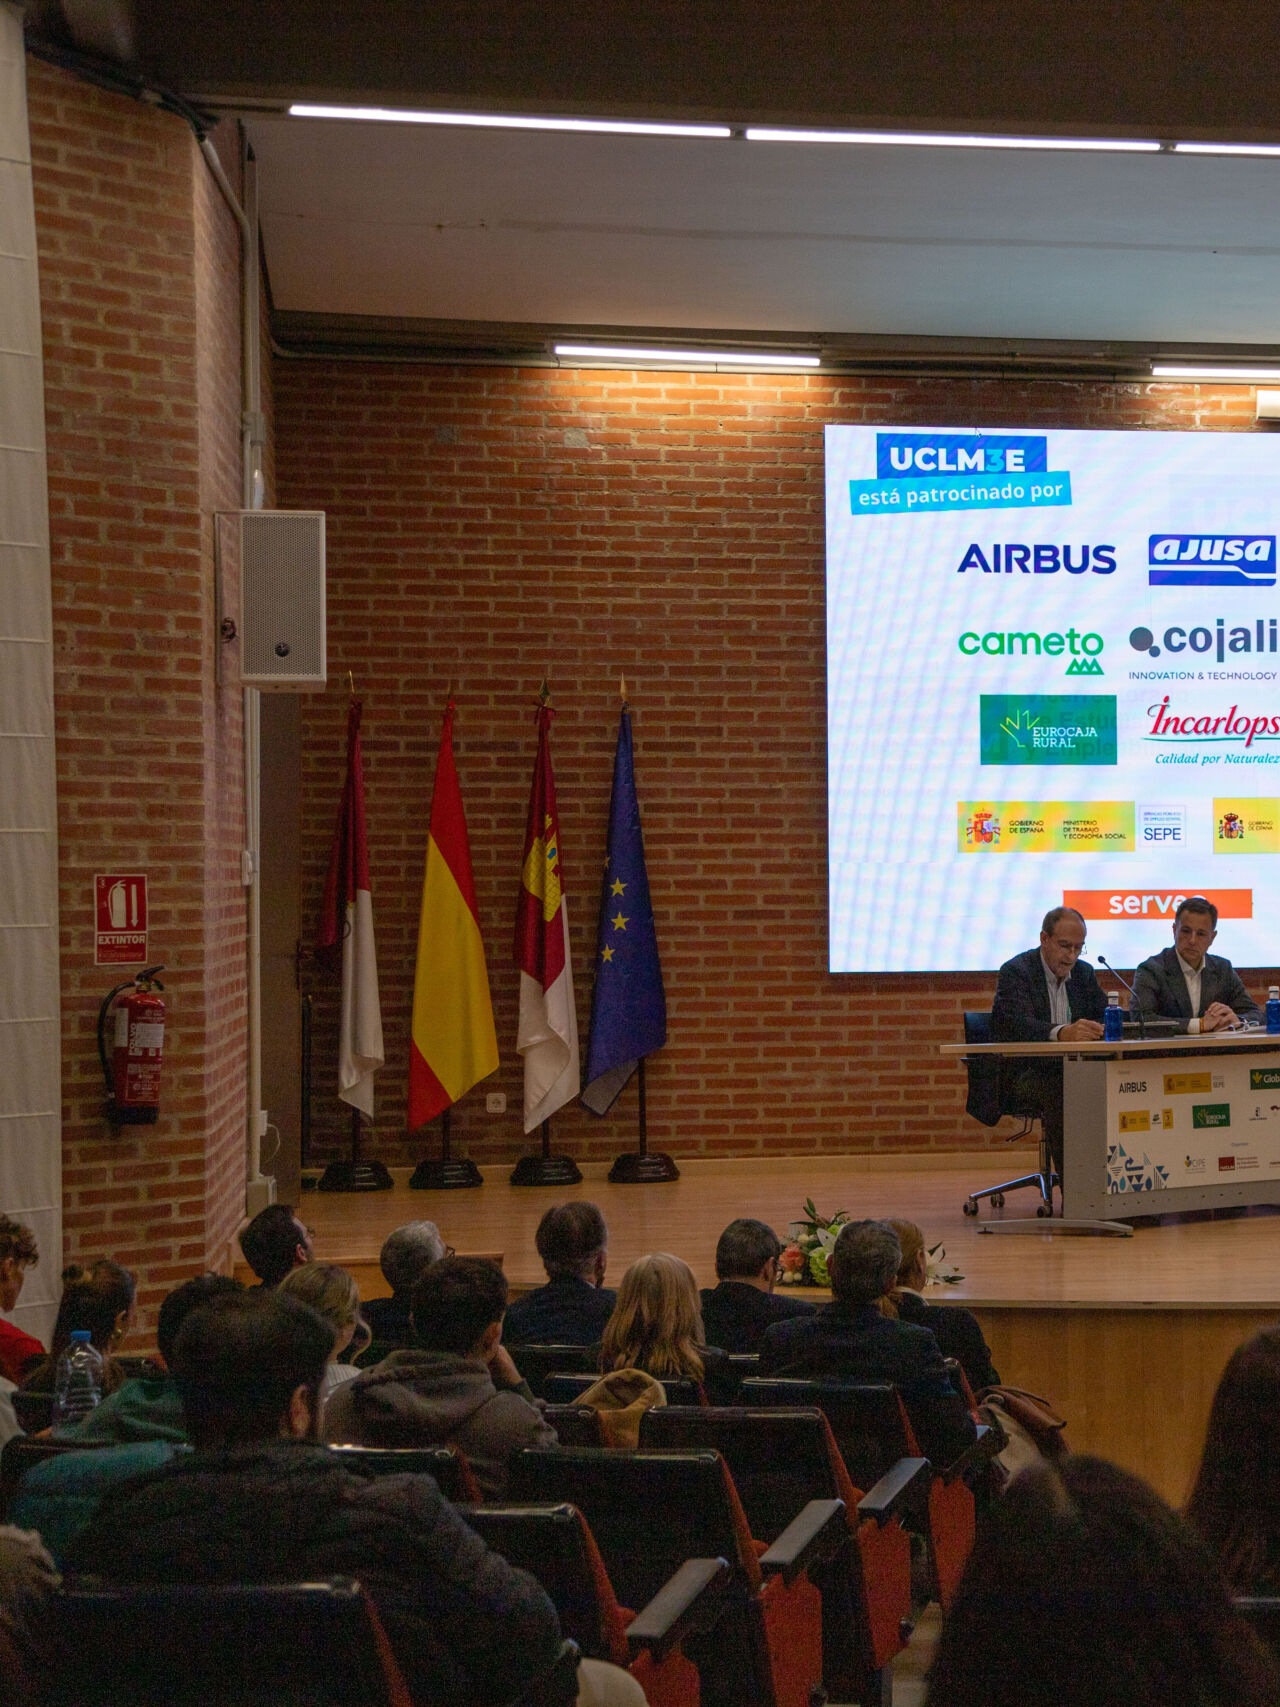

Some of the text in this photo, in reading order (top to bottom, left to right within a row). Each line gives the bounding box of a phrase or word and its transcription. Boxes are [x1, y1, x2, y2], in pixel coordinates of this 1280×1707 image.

[890, 447, 1025, 472] UCLM3E
[859, 482, 1063, 507] está patrocinado por
[1153, 538, 1271, 562] ajusa
[957, 543, 1117, 574] AIRBUS
[958, 627, 1104, 656] cameto
[1163, 618, 1278, 663] cojali
[1129, 672, 1278, 680] INNOVATION & TECHNOLOGY
[1033, 727, 1098, 737] EUROCAJA
[1033, 737, 1076, 748] RURAL
[1155, 753, 1198, 764] Calidad
[1201, 756, 1220, 766] por
[1144, 828, 1181, 841] SEPE
[1109, 895, 1206, 914] serve
[98, 935, 145, 944] EXTINTOR
[1119, 1081, 1147, 1094] AIRBUS
